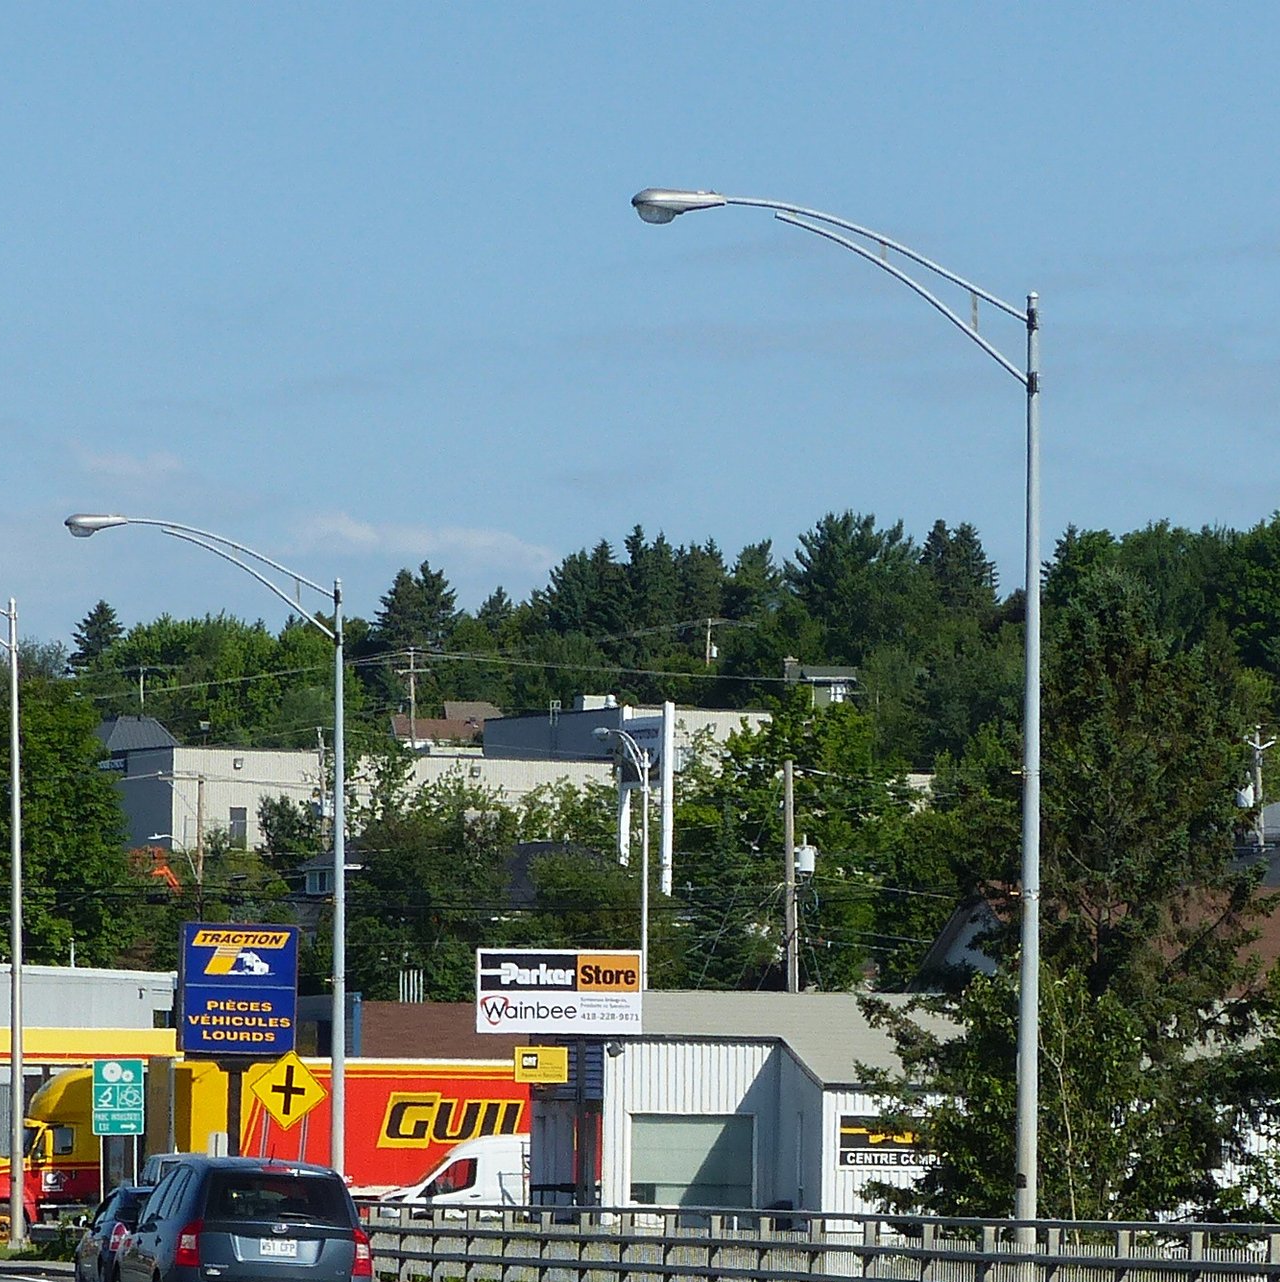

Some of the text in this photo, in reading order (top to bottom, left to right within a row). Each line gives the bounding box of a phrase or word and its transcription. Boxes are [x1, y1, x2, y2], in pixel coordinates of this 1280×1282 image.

[201, 932, 283, 945] TRACTION
[500, 962, 637, 986] Parker Store
[206, 999, 273, 1012] PIÈCES
[483, 1000, 578, 1020] Wainbee
[188, 1013, 291, 1028] VÉHICULES
[202, 1030, 276, 1042] LOURDS
[846, 1152, 898, 1165] CENTRE
